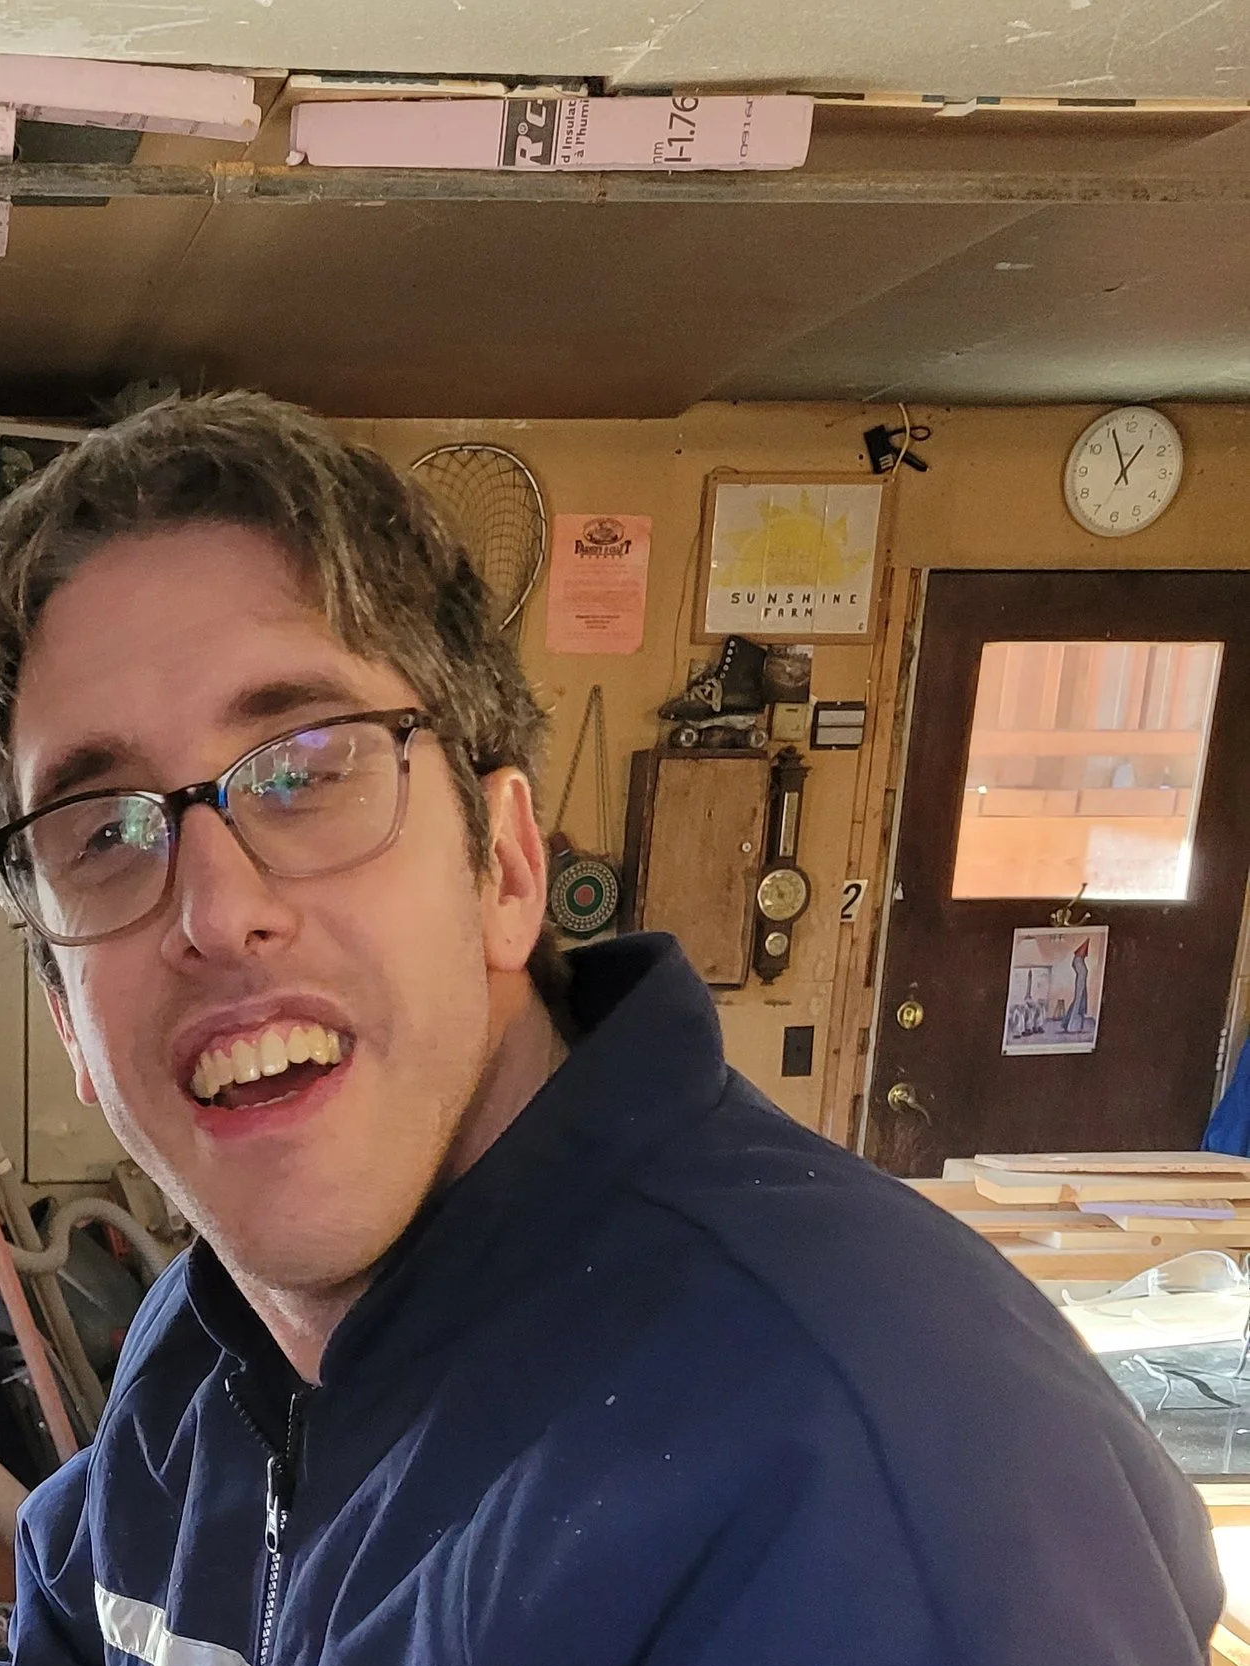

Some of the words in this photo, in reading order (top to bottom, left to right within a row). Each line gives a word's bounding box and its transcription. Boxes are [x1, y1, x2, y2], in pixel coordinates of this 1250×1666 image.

[561, 100, 577, 150] Insulat
[576, 148, 585, 158] à
[1125, 421, 1139, 433] 12
[1089, 443, 1103, 455] 10
[1156, 445, 1167, 457] 2
[1078, 466, 1089, 478] 9
[1157, 468, 1168, 480] 3
[1079, 487, 1090, 499] 8
[1147, 489, 1158, 500] 4
[1093, 503, 1102, 516] 7
[1131, 504, 1142, 517] 5
[1109, 511, 1120, 523] 6
[730, 592, 858, 604] SUNSHINE
[764, 607, 814, 618] FARM
[840, 881, 863, 919] 2
